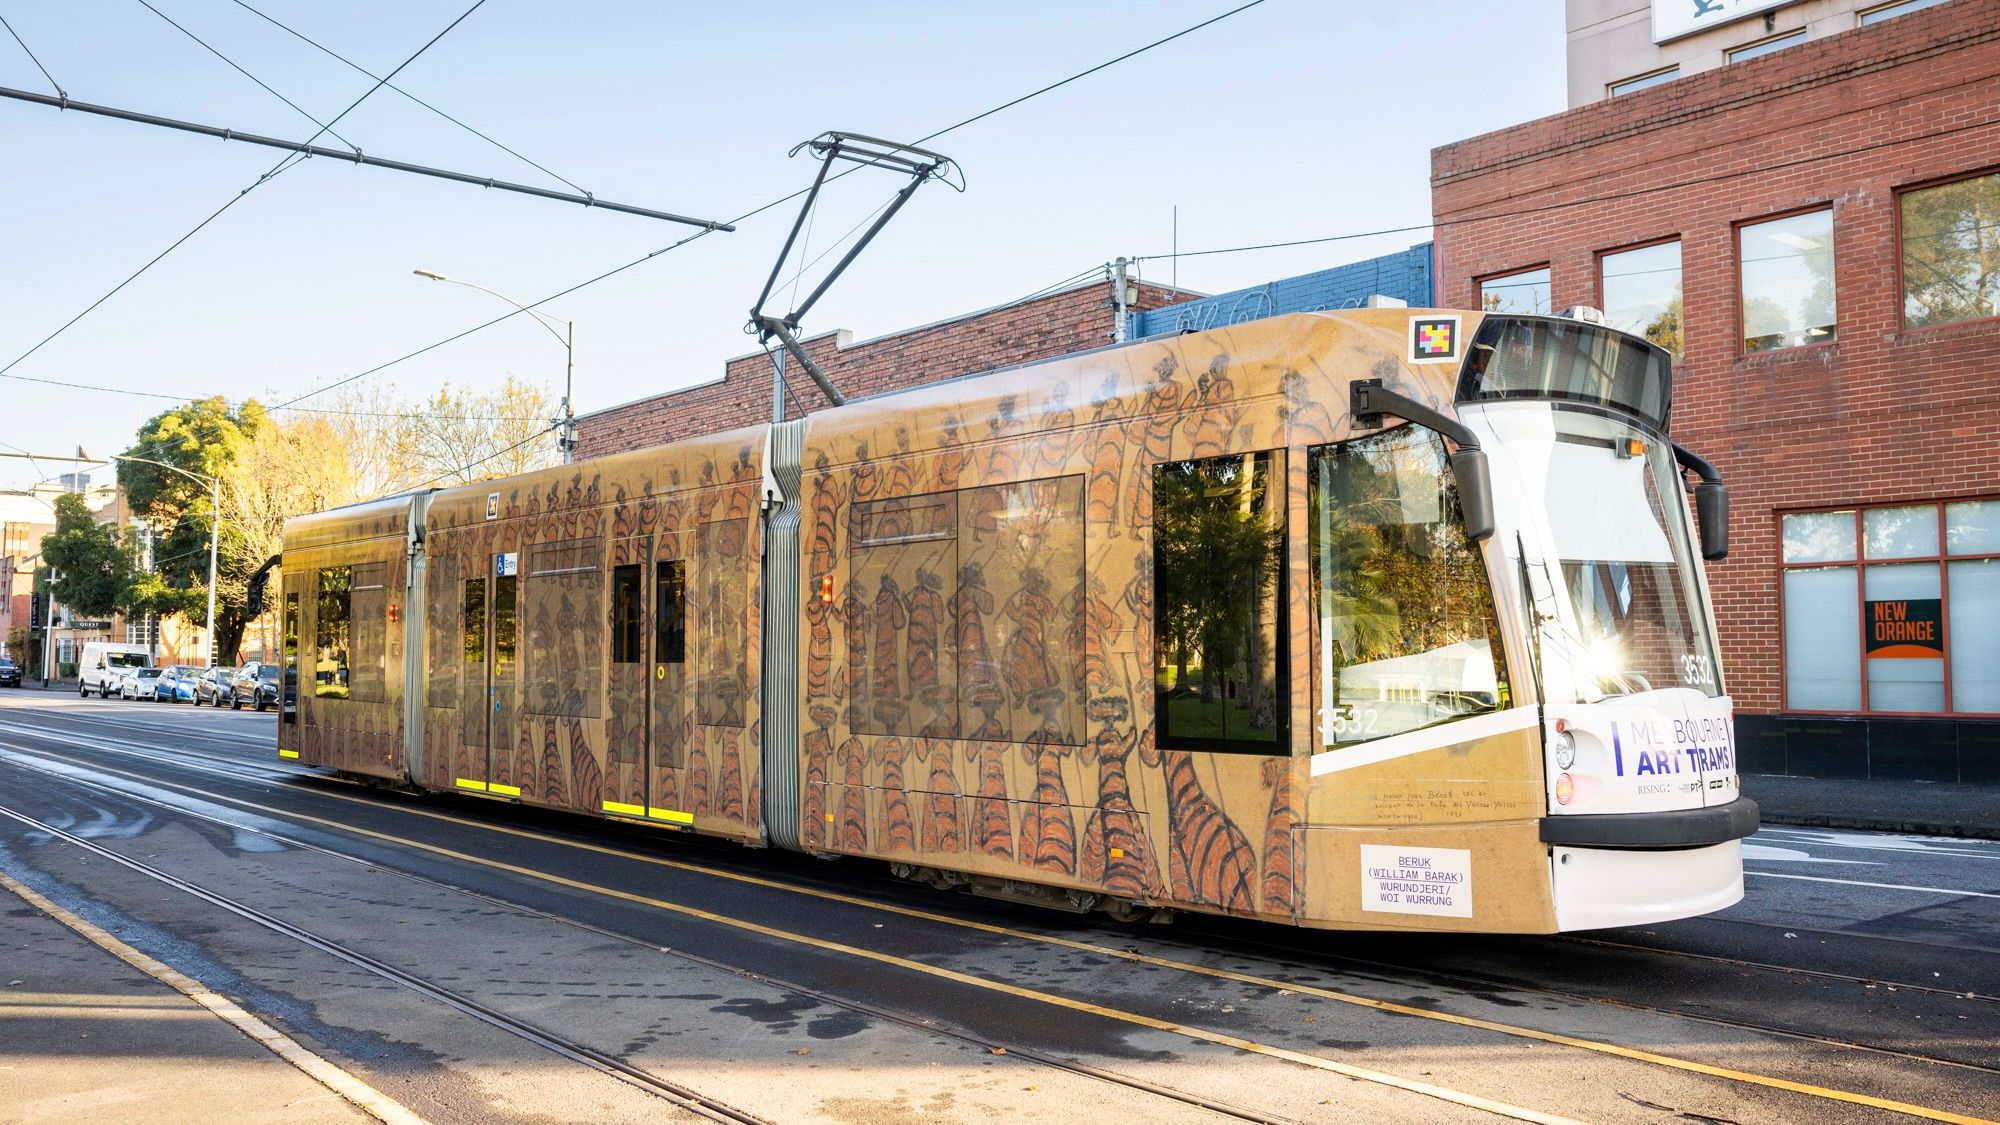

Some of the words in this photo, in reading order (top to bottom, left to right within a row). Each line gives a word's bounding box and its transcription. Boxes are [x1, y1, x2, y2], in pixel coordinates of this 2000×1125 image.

[505, 559, 516, 570] Entry
[1874, 601, 1908, 621] NEW
[1874, 620, 1935, 641] ORANGE
[1680, 654, 1713, 685] 3532
[1317, 708, 1379, 734] 3532
[1630, 718, 1726, 745] MEBOURNE
[1637, 750, 1681, 776] ART
[1686, 746, 1729, 772] TRAMS
[1398, 856, 1431, 868] BERUK
[1368, 868, 1419, 881] (WILLIAM
[1424, 871, 1464, 883] BARAK)
[1379, 881, 1452, 895] WURUNDJERI/
[1380, 892, 1400, 903] WOI
[1405, 894, 1453, 907] WURRUNG
